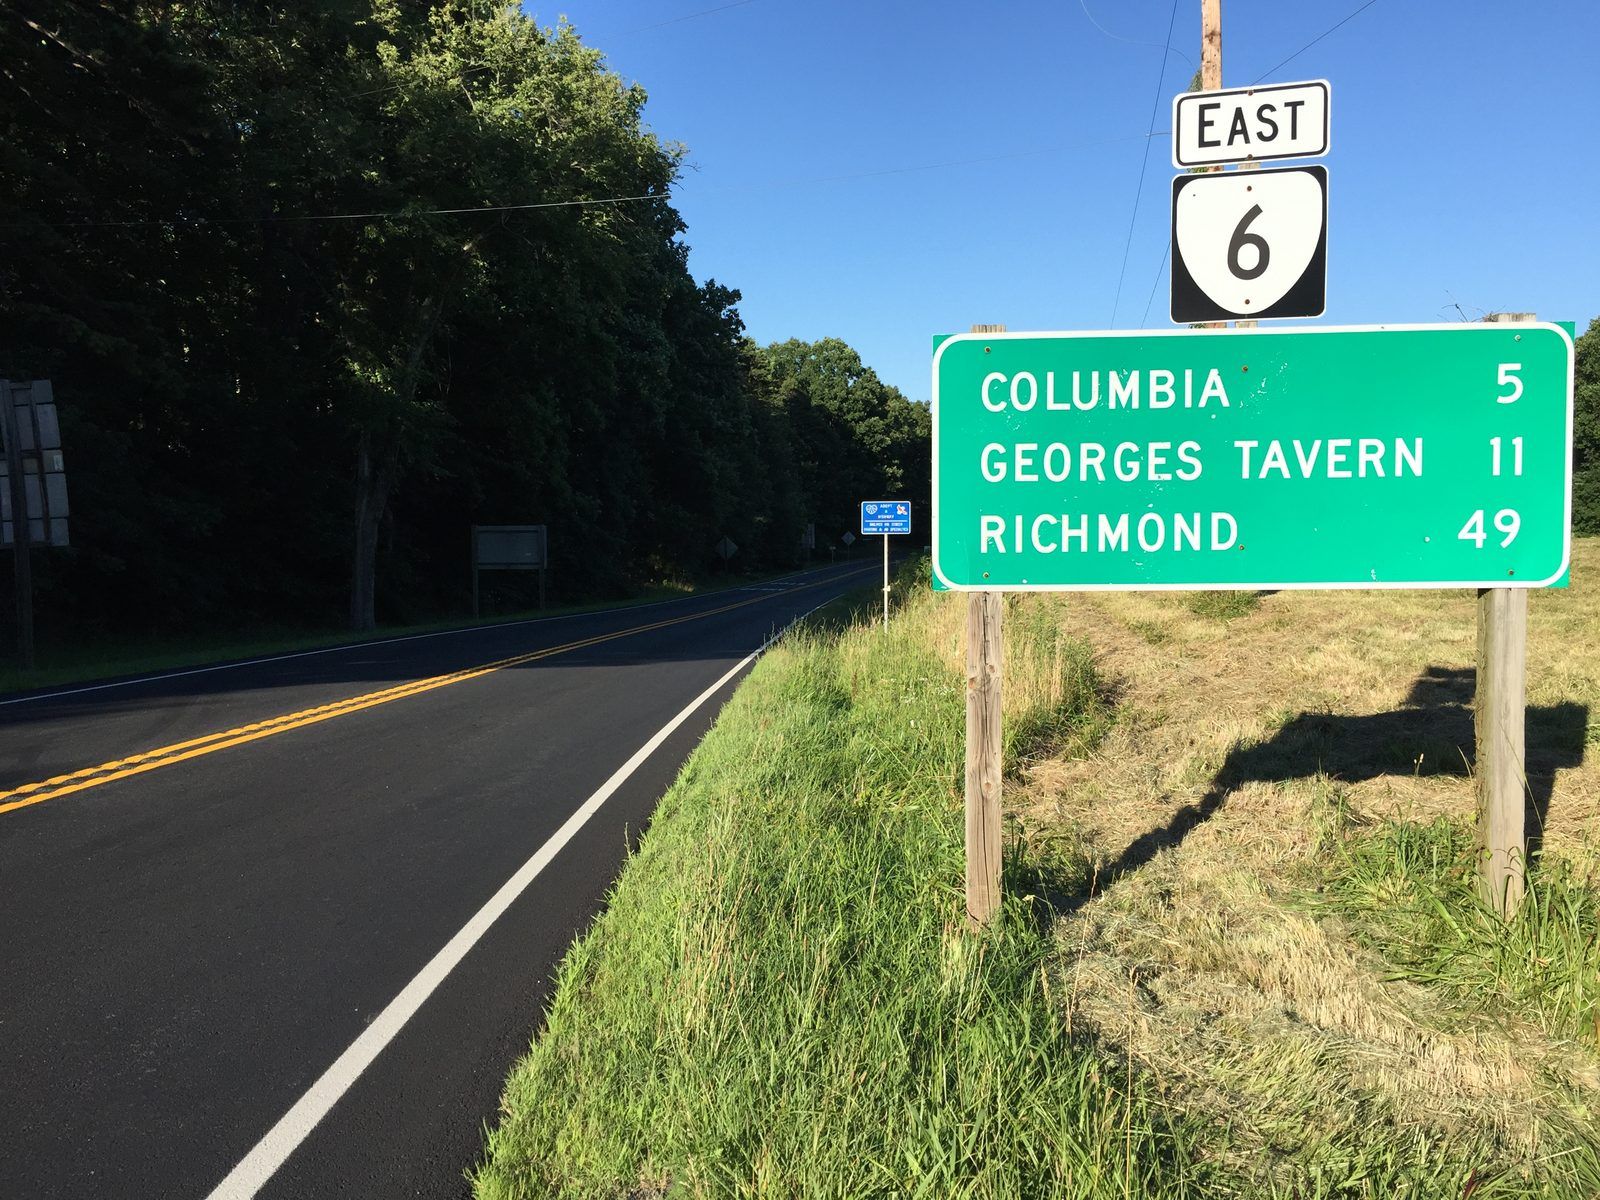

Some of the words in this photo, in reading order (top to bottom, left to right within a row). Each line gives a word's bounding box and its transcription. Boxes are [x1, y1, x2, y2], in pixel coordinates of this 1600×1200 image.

[1197, 100, 1305, 149] EAST
[1227, 203, 1271, 281] 6
[981, 368, 1230, 413] COLUMBIA
[1496, 362, 1524, 404] 5
[980, 440, 1203, 483] GEORGES
[1234, 437, 1424, 479] TAVERN
[1489, 436, 1523, 477] 11
[980, 512, 1238, 554] RICHMOND
[1457, 508, 1522, 549] 49
